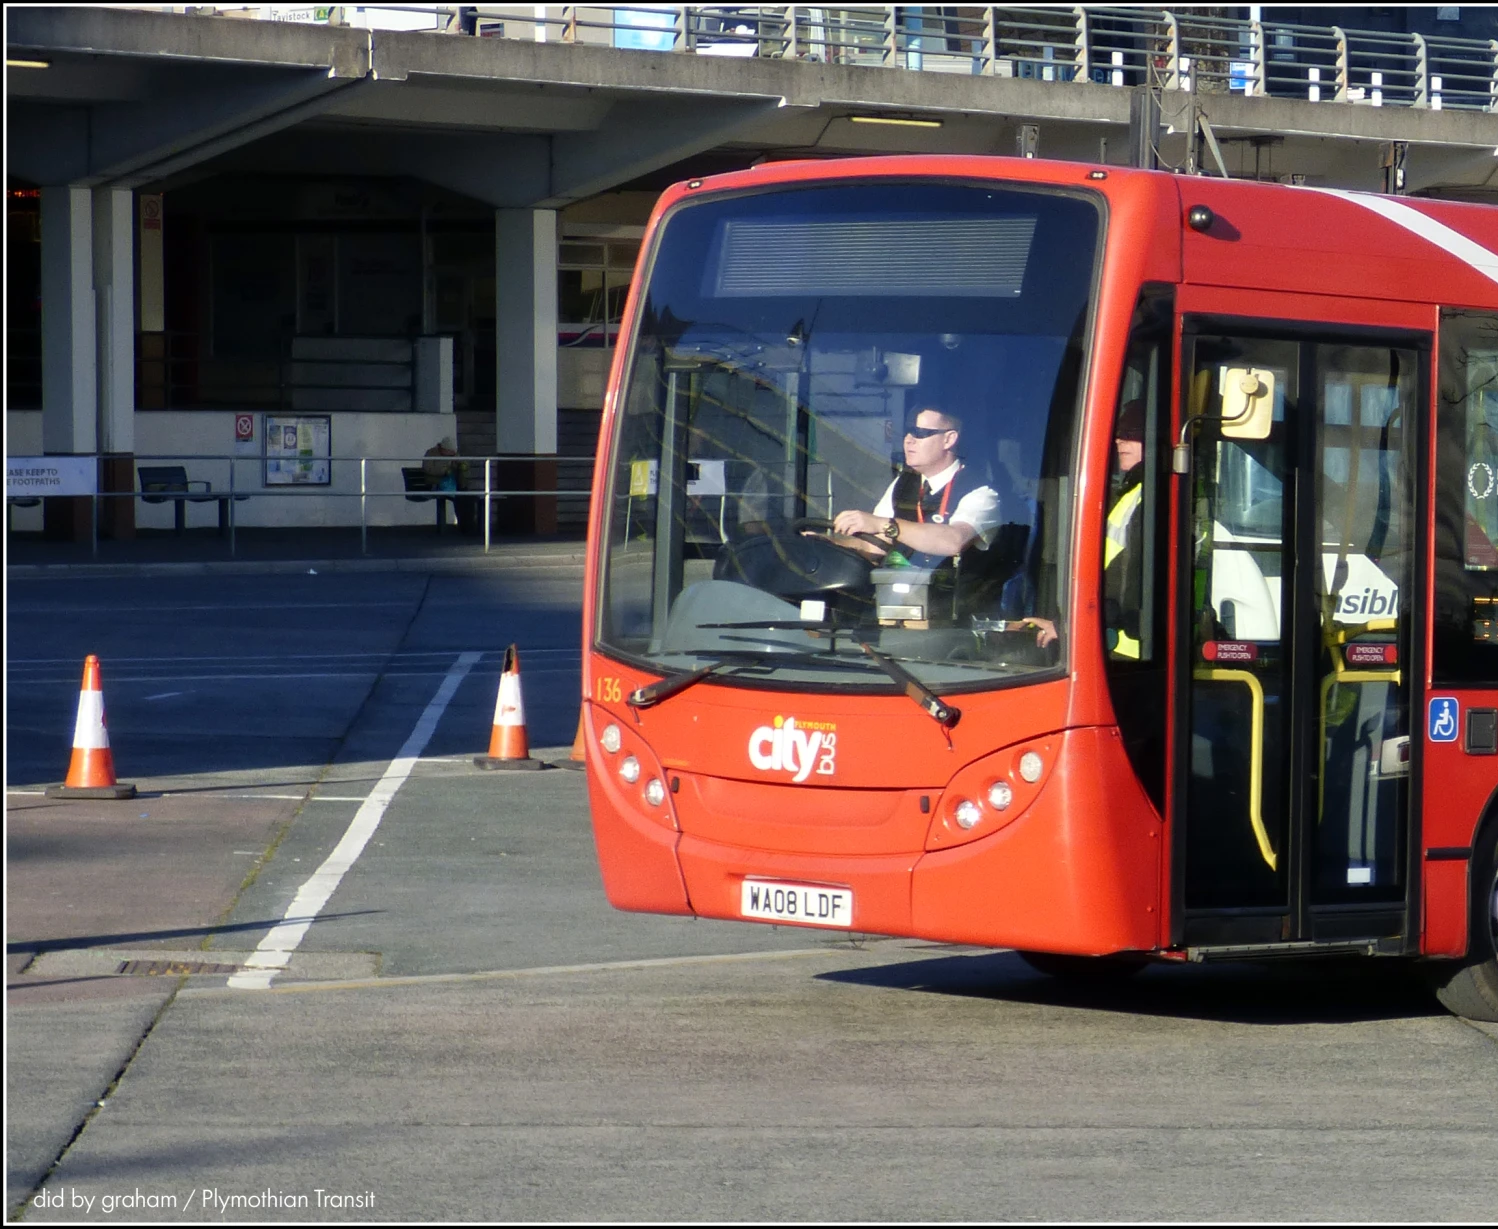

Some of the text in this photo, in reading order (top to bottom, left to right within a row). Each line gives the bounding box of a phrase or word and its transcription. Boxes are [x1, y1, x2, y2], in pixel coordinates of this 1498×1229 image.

[25, 468, 45, 476] KEEP
[46, 468, 58, 476] TO
[13, 477, 60, 486] FOOTPATHS
[1356, 646, 1384, 654] EMERGENCY
[596, 677, 622, 703] 136
[795, 721, 836, 731] PLYMOUTH
[748, 714, 822, 783] city
[816, 733, 837, 775] bus
[750, 886, 843, 919] WA08 LDF
